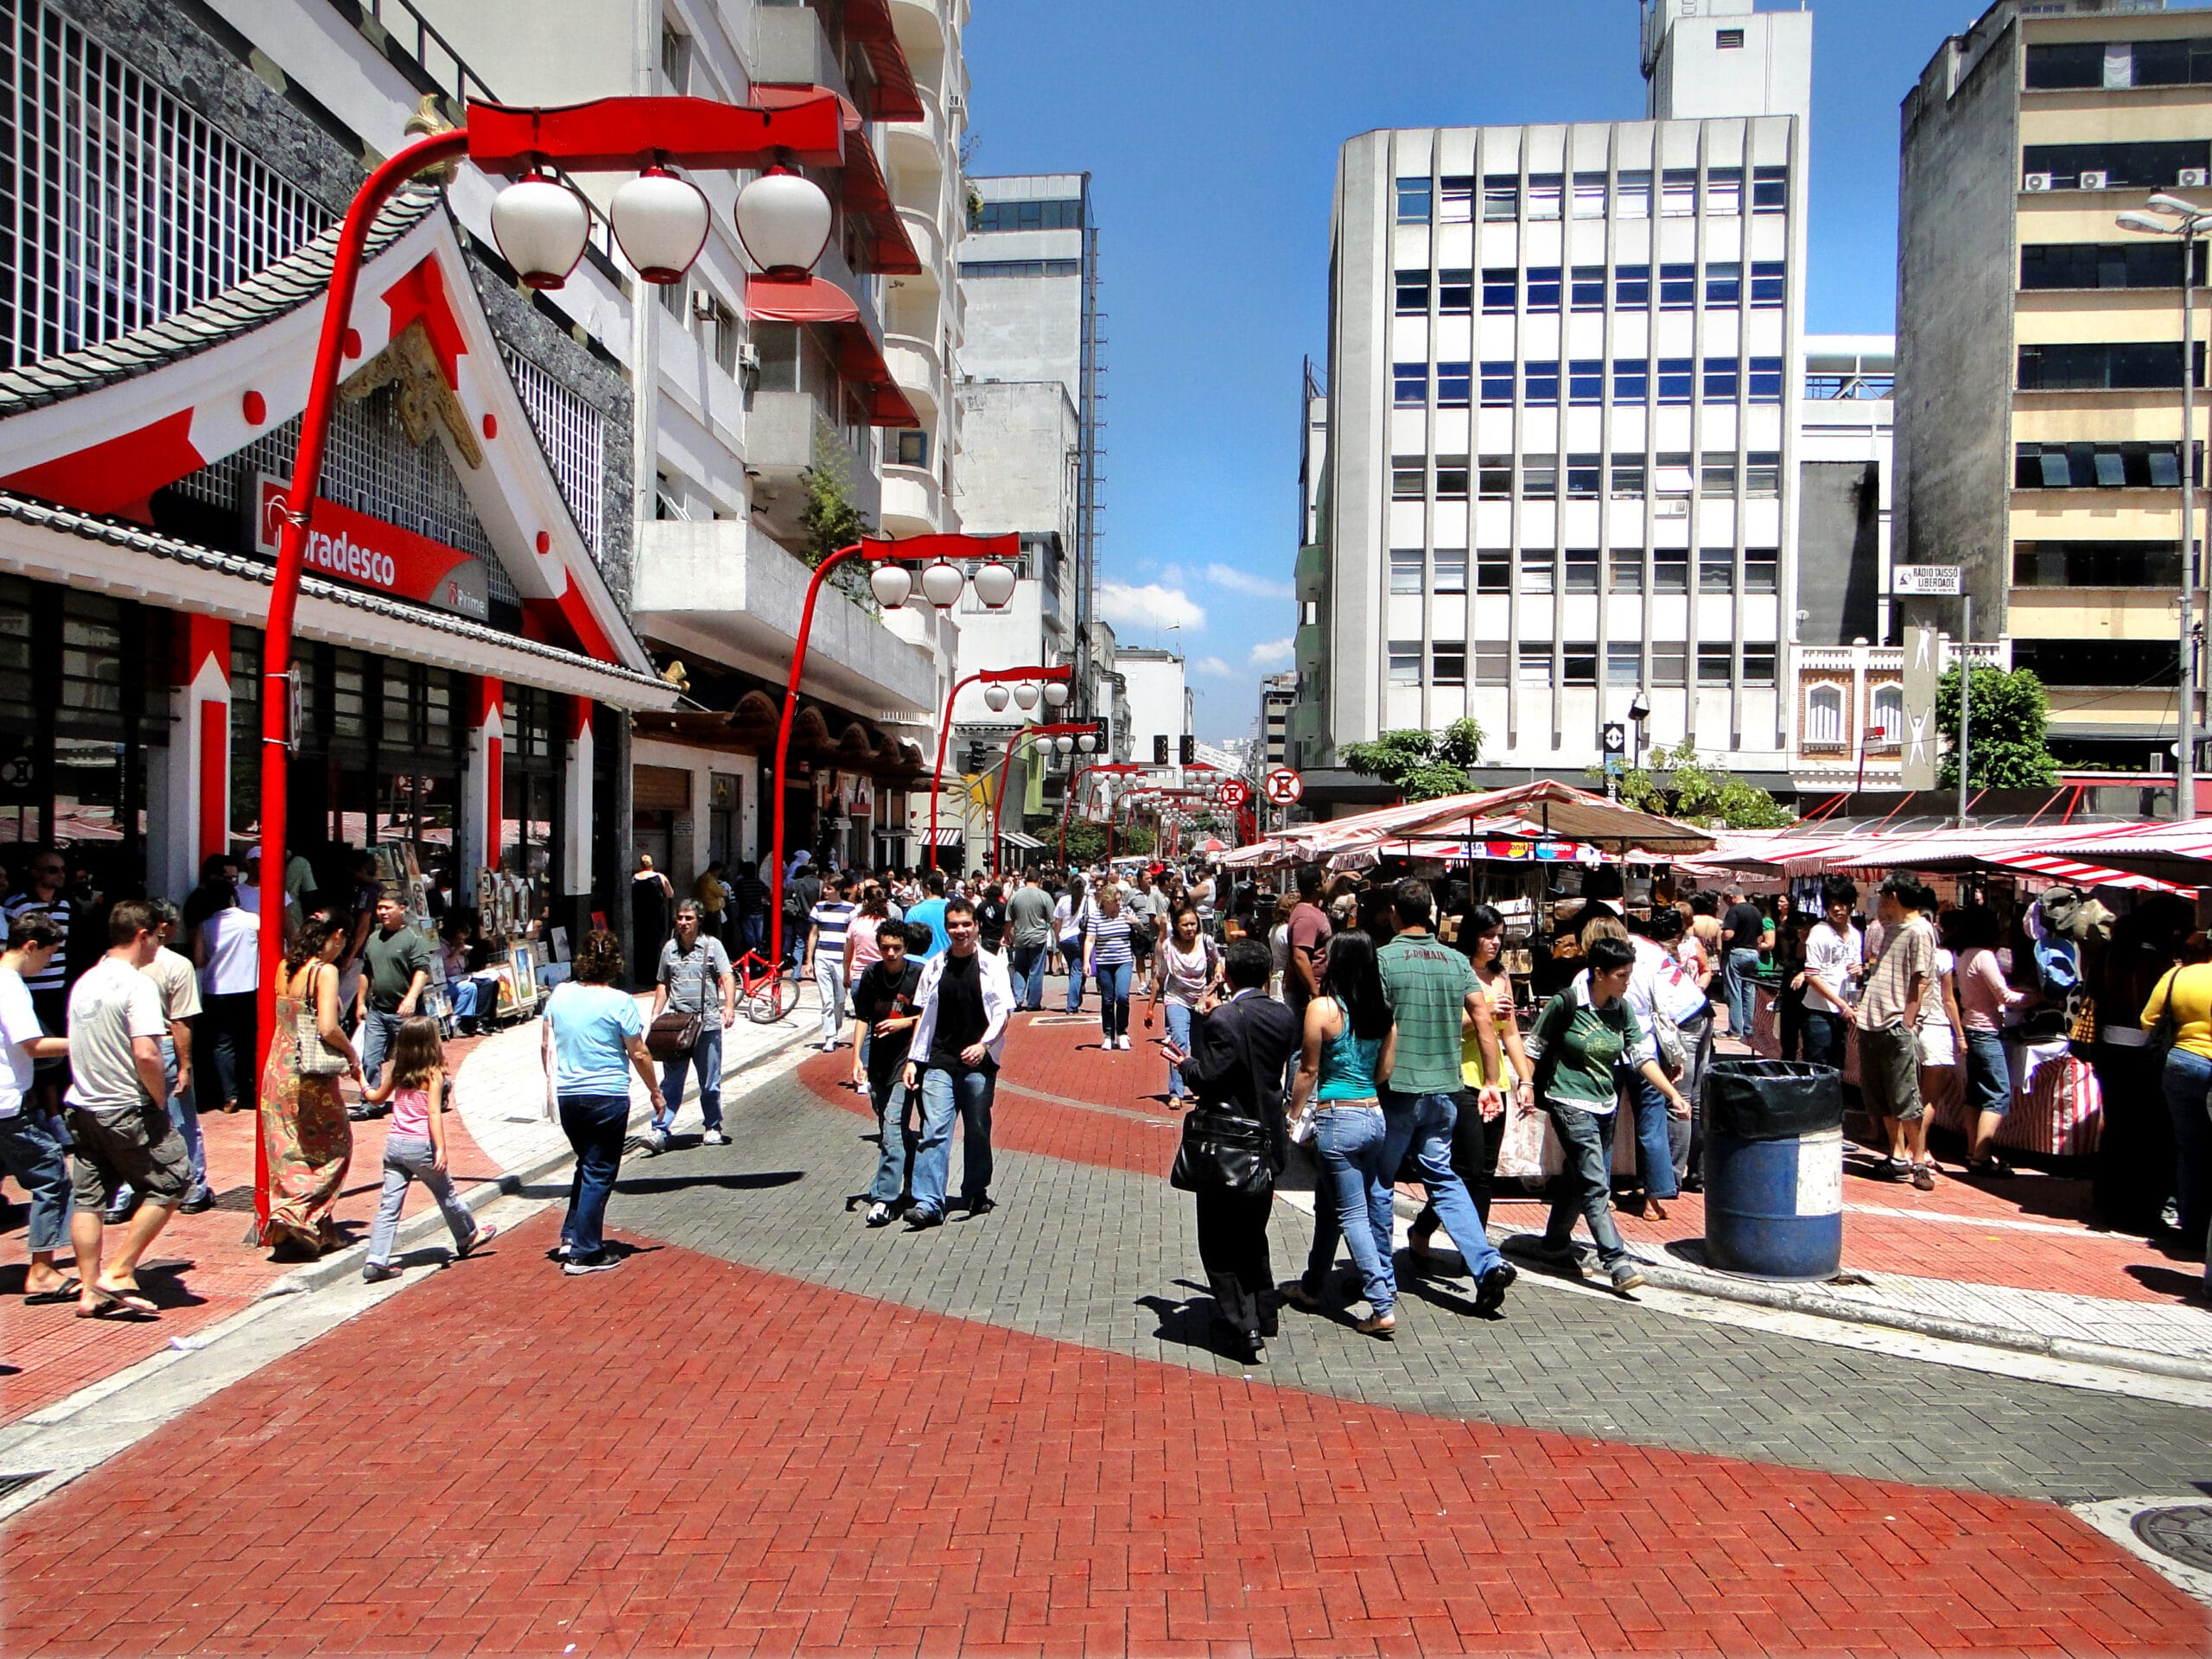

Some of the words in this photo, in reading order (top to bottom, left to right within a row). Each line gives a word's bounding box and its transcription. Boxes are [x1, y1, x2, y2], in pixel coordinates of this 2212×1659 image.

[304, 530, 395, 586] radesco
[1918, 578, 1955, 588] LIBERDADE
[458, 589, 485, 614] Prime
[1404, 950, 1448, 964] Z-DOMAIN
